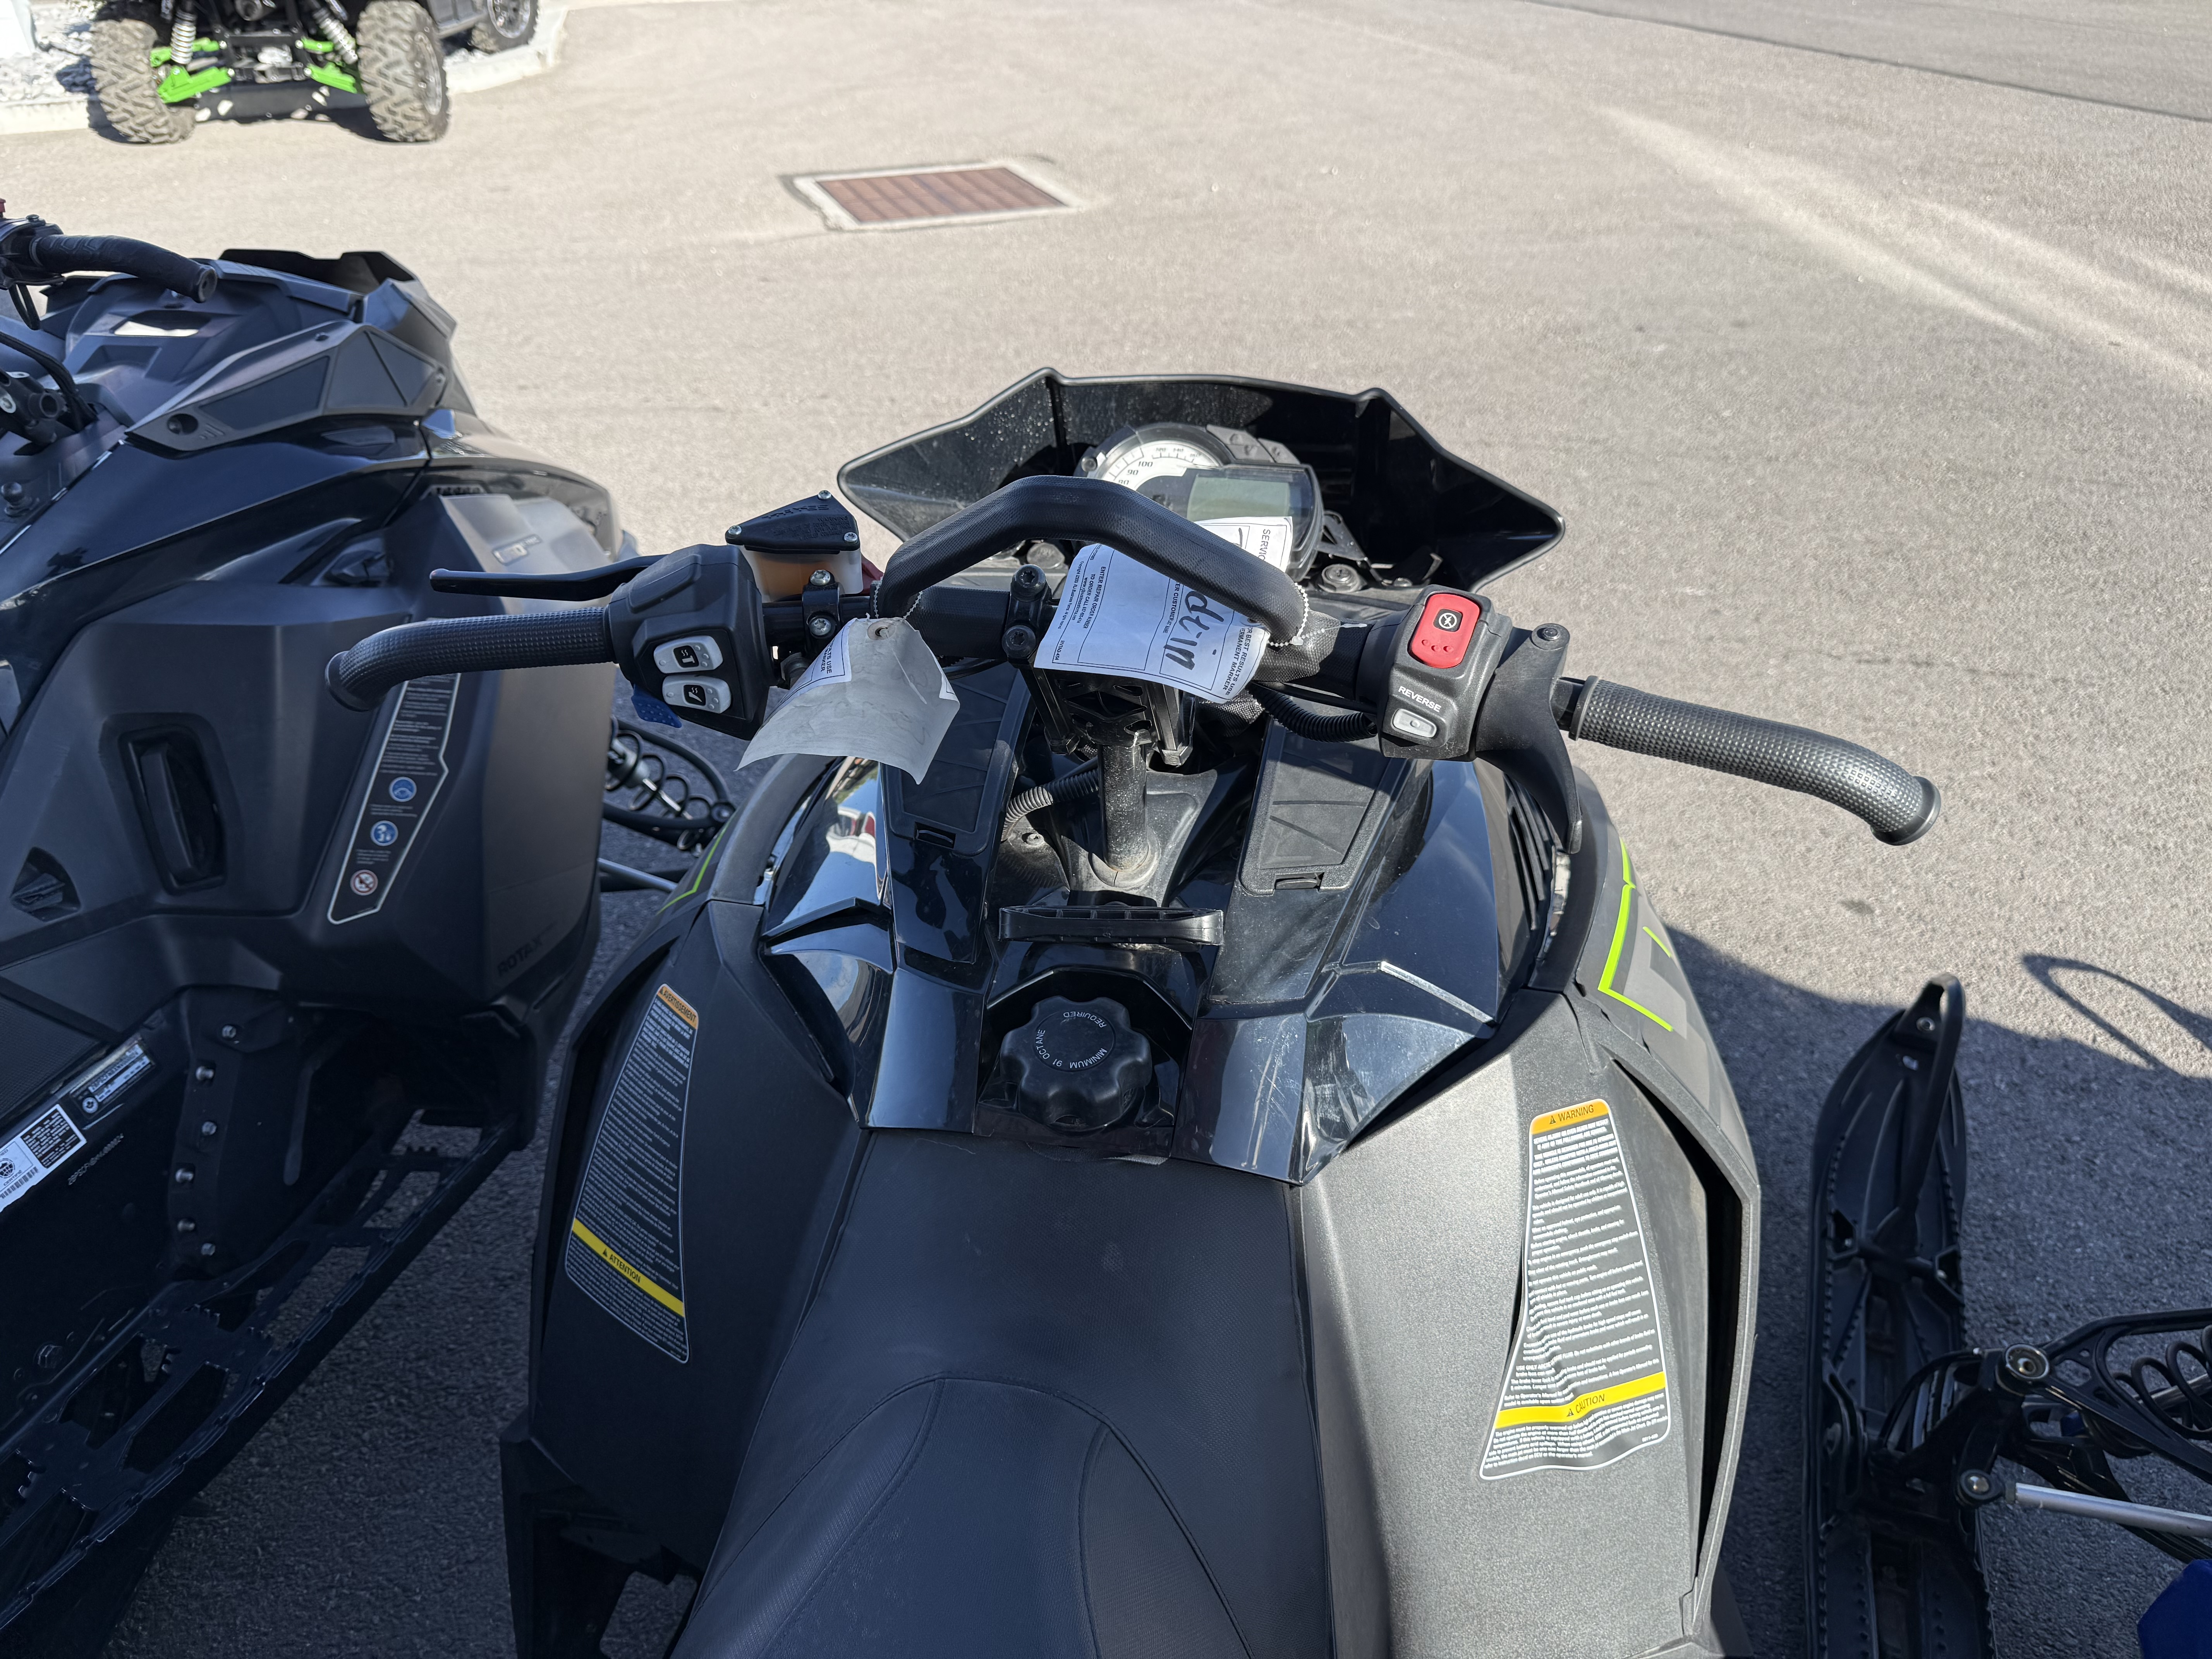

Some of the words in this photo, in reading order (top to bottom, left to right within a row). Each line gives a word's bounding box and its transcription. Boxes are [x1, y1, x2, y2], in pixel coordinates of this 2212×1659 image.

[1258, 529, 1271, 561] SERVIC
[1098, 566, 1106, 584] ENTER
[1093, 584, 1102, 603] REPAIR
[1089, 603, 1097, 616] ORDER
[1170, 592, 1178, 621] CUSTOMER
[1234, 628, 1246, 661] ERMANENT
[1243, 635, 1252, 652] BEST
[1223, 661, 1237, 690] MARKER
[1233, 651, 1247, 682] RESULTS
[1398, 686, 1441, 713] REVERSE
[663, 990, 697, 1023] AVERTISSEMENT
[1063, 1011, 1107, 1028] REQUIRED
[1036, 1029, 1050, 1060] OCTANE
[1053, 1058, 1063, 1067] 91
[1070, 1048, 1108, 1069] MINIMUM
[1558, 1104, 1594, 1122] WARNING
[610, 1254, 641, 1283] ATTENTION
[1575, 1393, 1606, 1413] CAUTION
